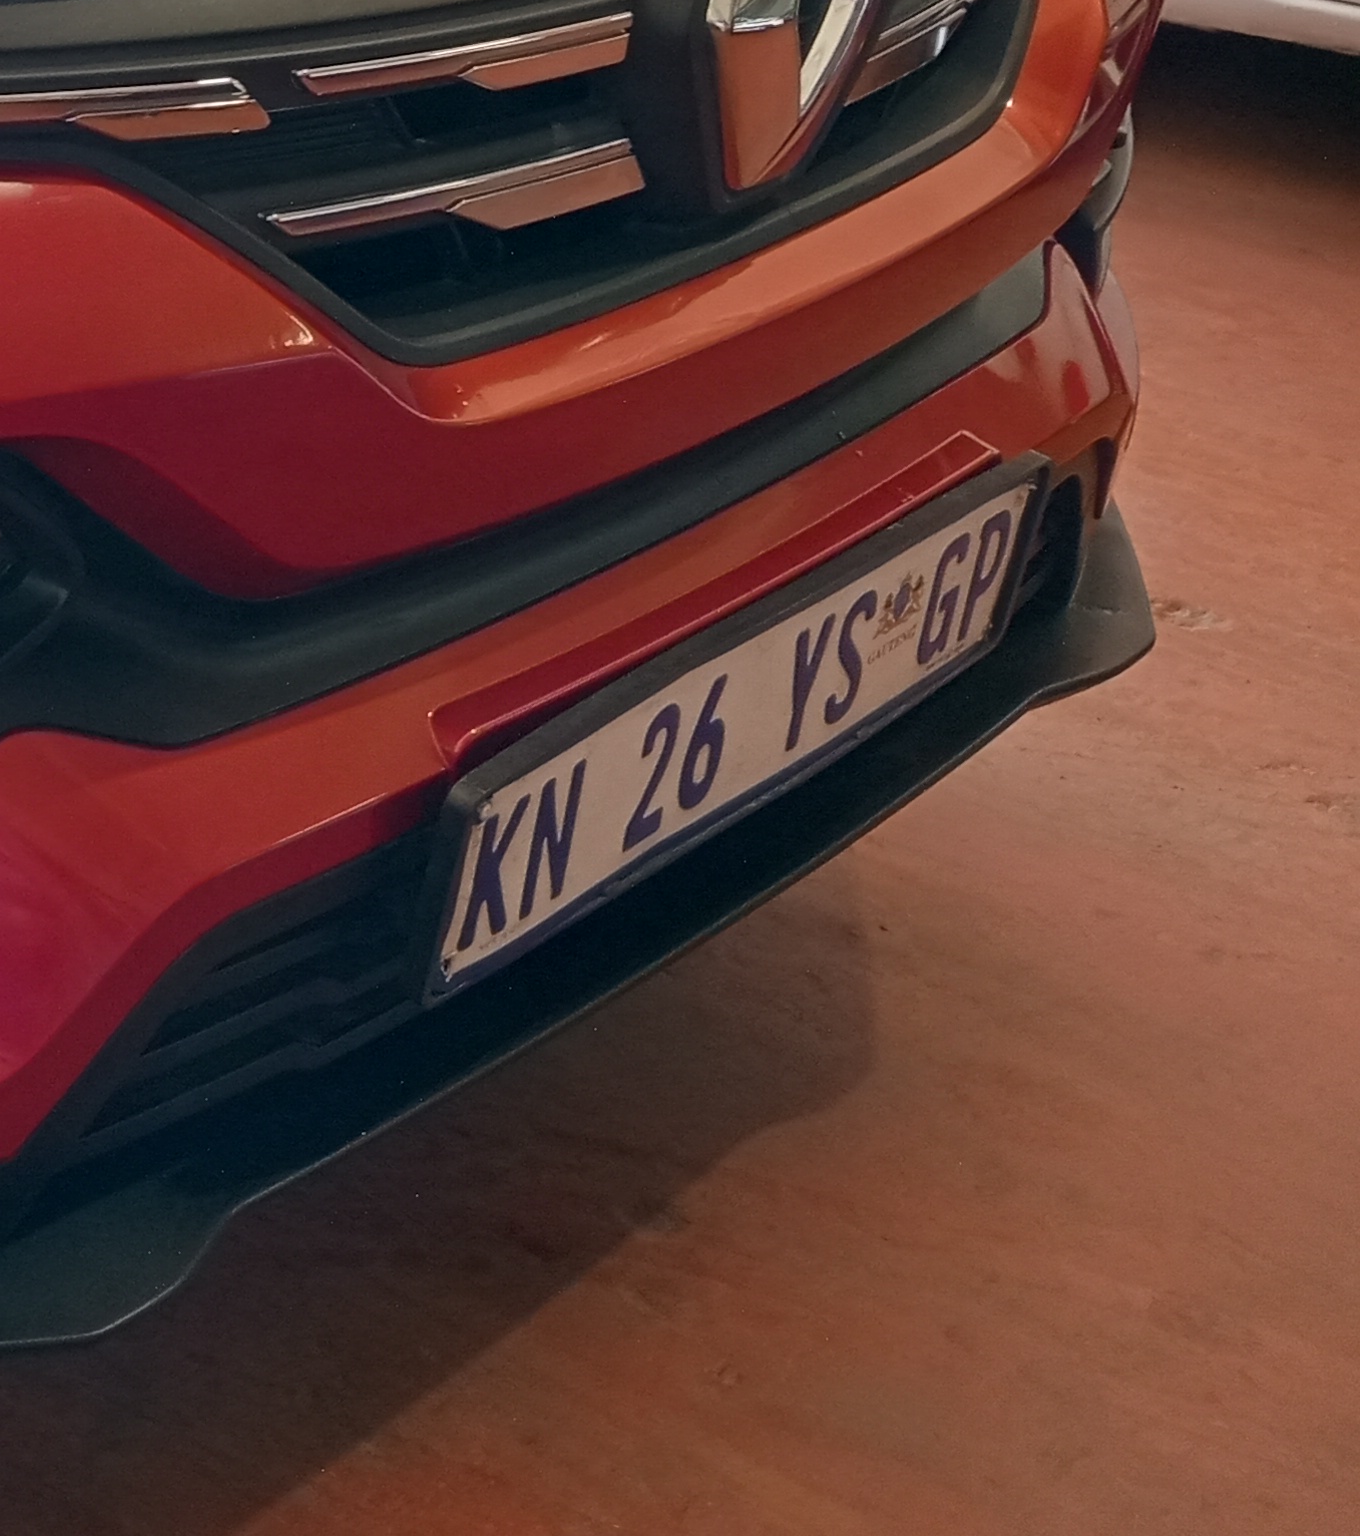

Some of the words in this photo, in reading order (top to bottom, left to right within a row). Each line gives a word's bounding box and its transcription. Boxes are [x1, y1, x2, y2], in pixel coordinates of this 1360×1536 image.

[457, 760, 587, 952] KN
[622, 673, 729, 853] 26
[785, 589, 877, 752] YS
[916, 509, 1012, 665] GP
